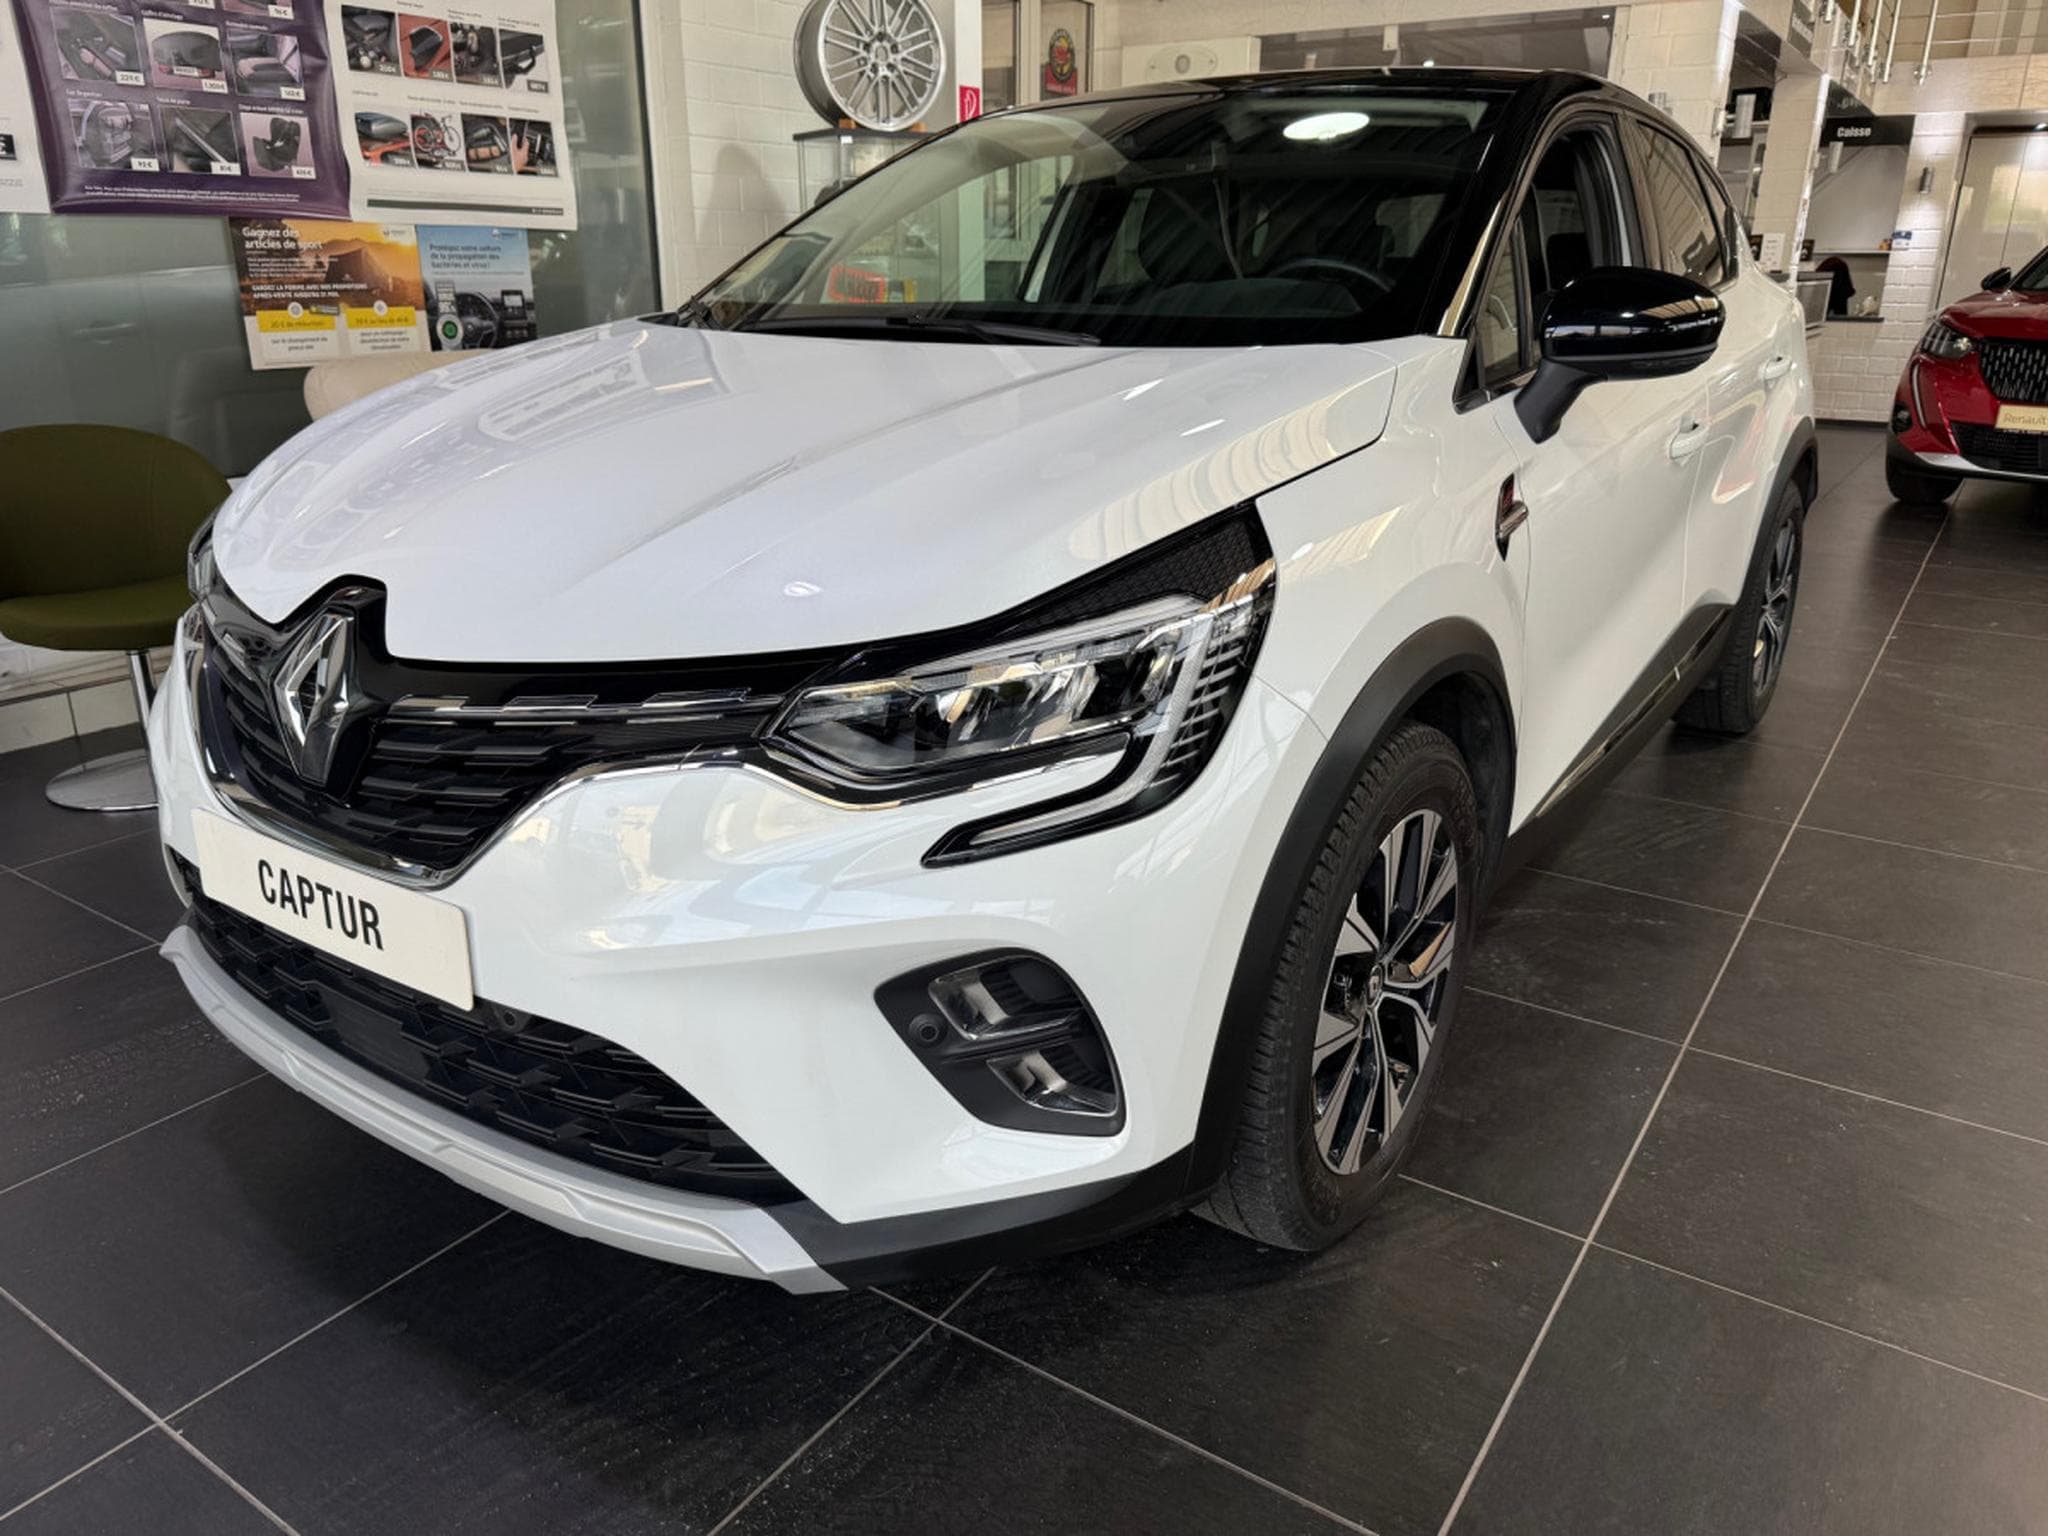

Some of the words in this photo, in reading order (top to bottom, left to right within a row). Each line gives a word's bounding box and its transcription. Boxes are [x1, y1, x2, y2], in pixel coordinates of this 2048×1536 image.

[241, 226, 281, 240] Gagnez
[282, 227, 300, 238] des
[244, 239, 282, 250] articles
[282, 239, 297, 250] de
[299, 240, 323, 252] sport
[257, 859, 384, 951] CAPTUR
